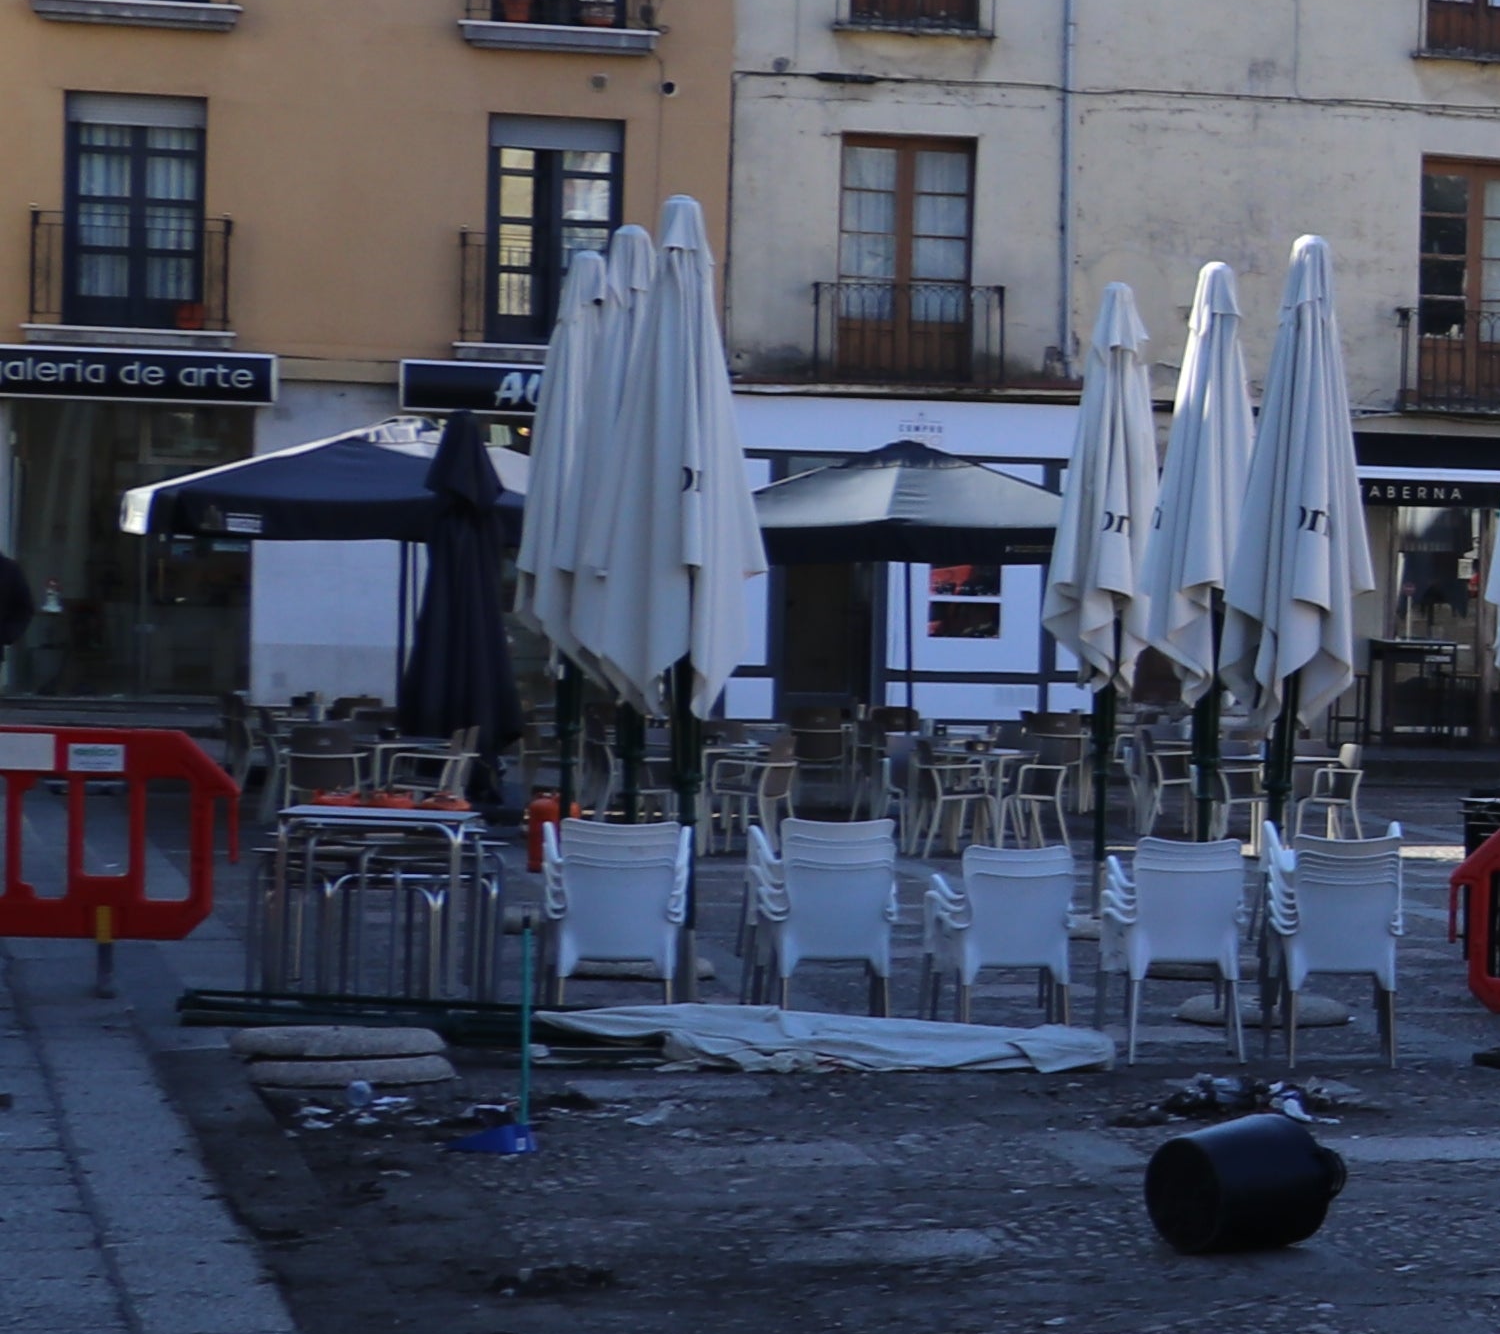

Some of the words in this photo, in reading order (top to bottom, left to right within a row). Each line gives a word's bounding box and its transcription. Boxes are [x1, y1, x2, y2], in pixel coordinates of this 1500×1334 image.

[119, 361, 165, 385] de
[178, 365, 254, 389] arte
[898, 424, 944, 433] COMPRO
